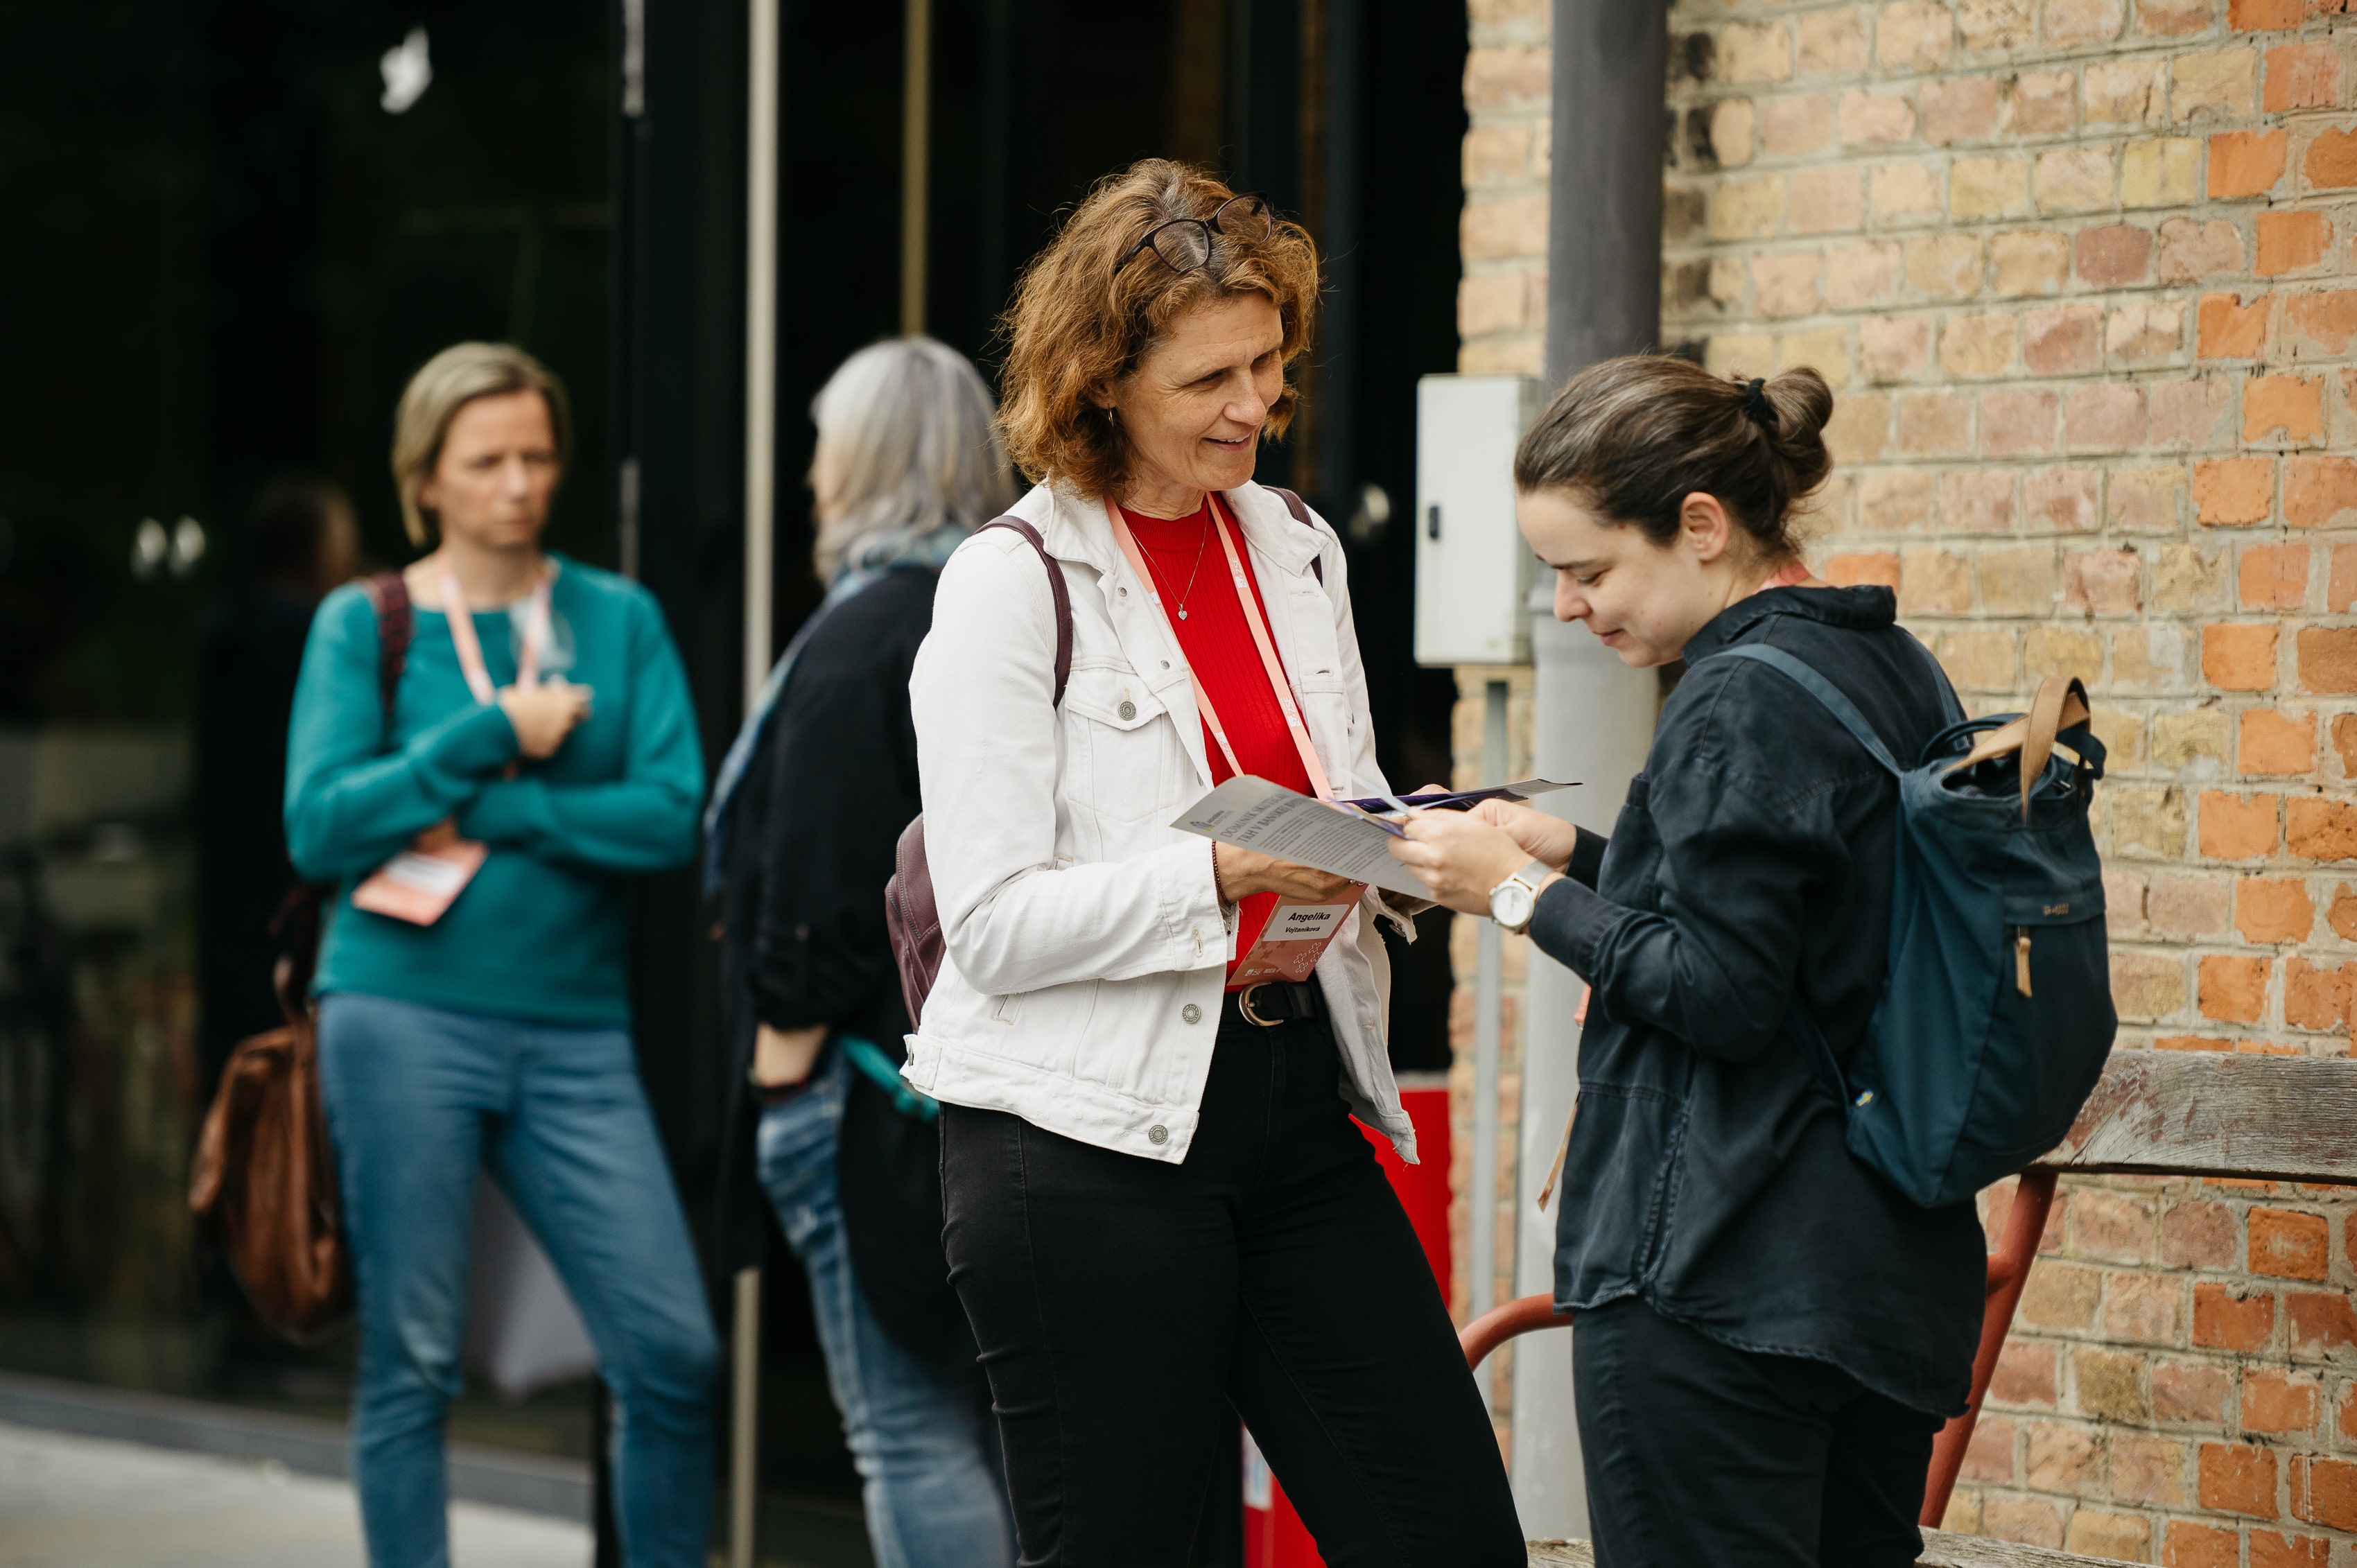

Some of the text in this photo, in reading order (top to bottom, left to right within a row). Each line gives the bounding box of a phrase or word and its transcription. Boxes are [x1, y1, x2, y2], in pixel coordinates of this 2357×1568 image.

[1231, 557, 1244, 575] ZSE
[1283, 697, 1296, 714] ZSE
[1236, 829, 1258, 842] TRH
[1288, 912, 1331, 923] Angelika
